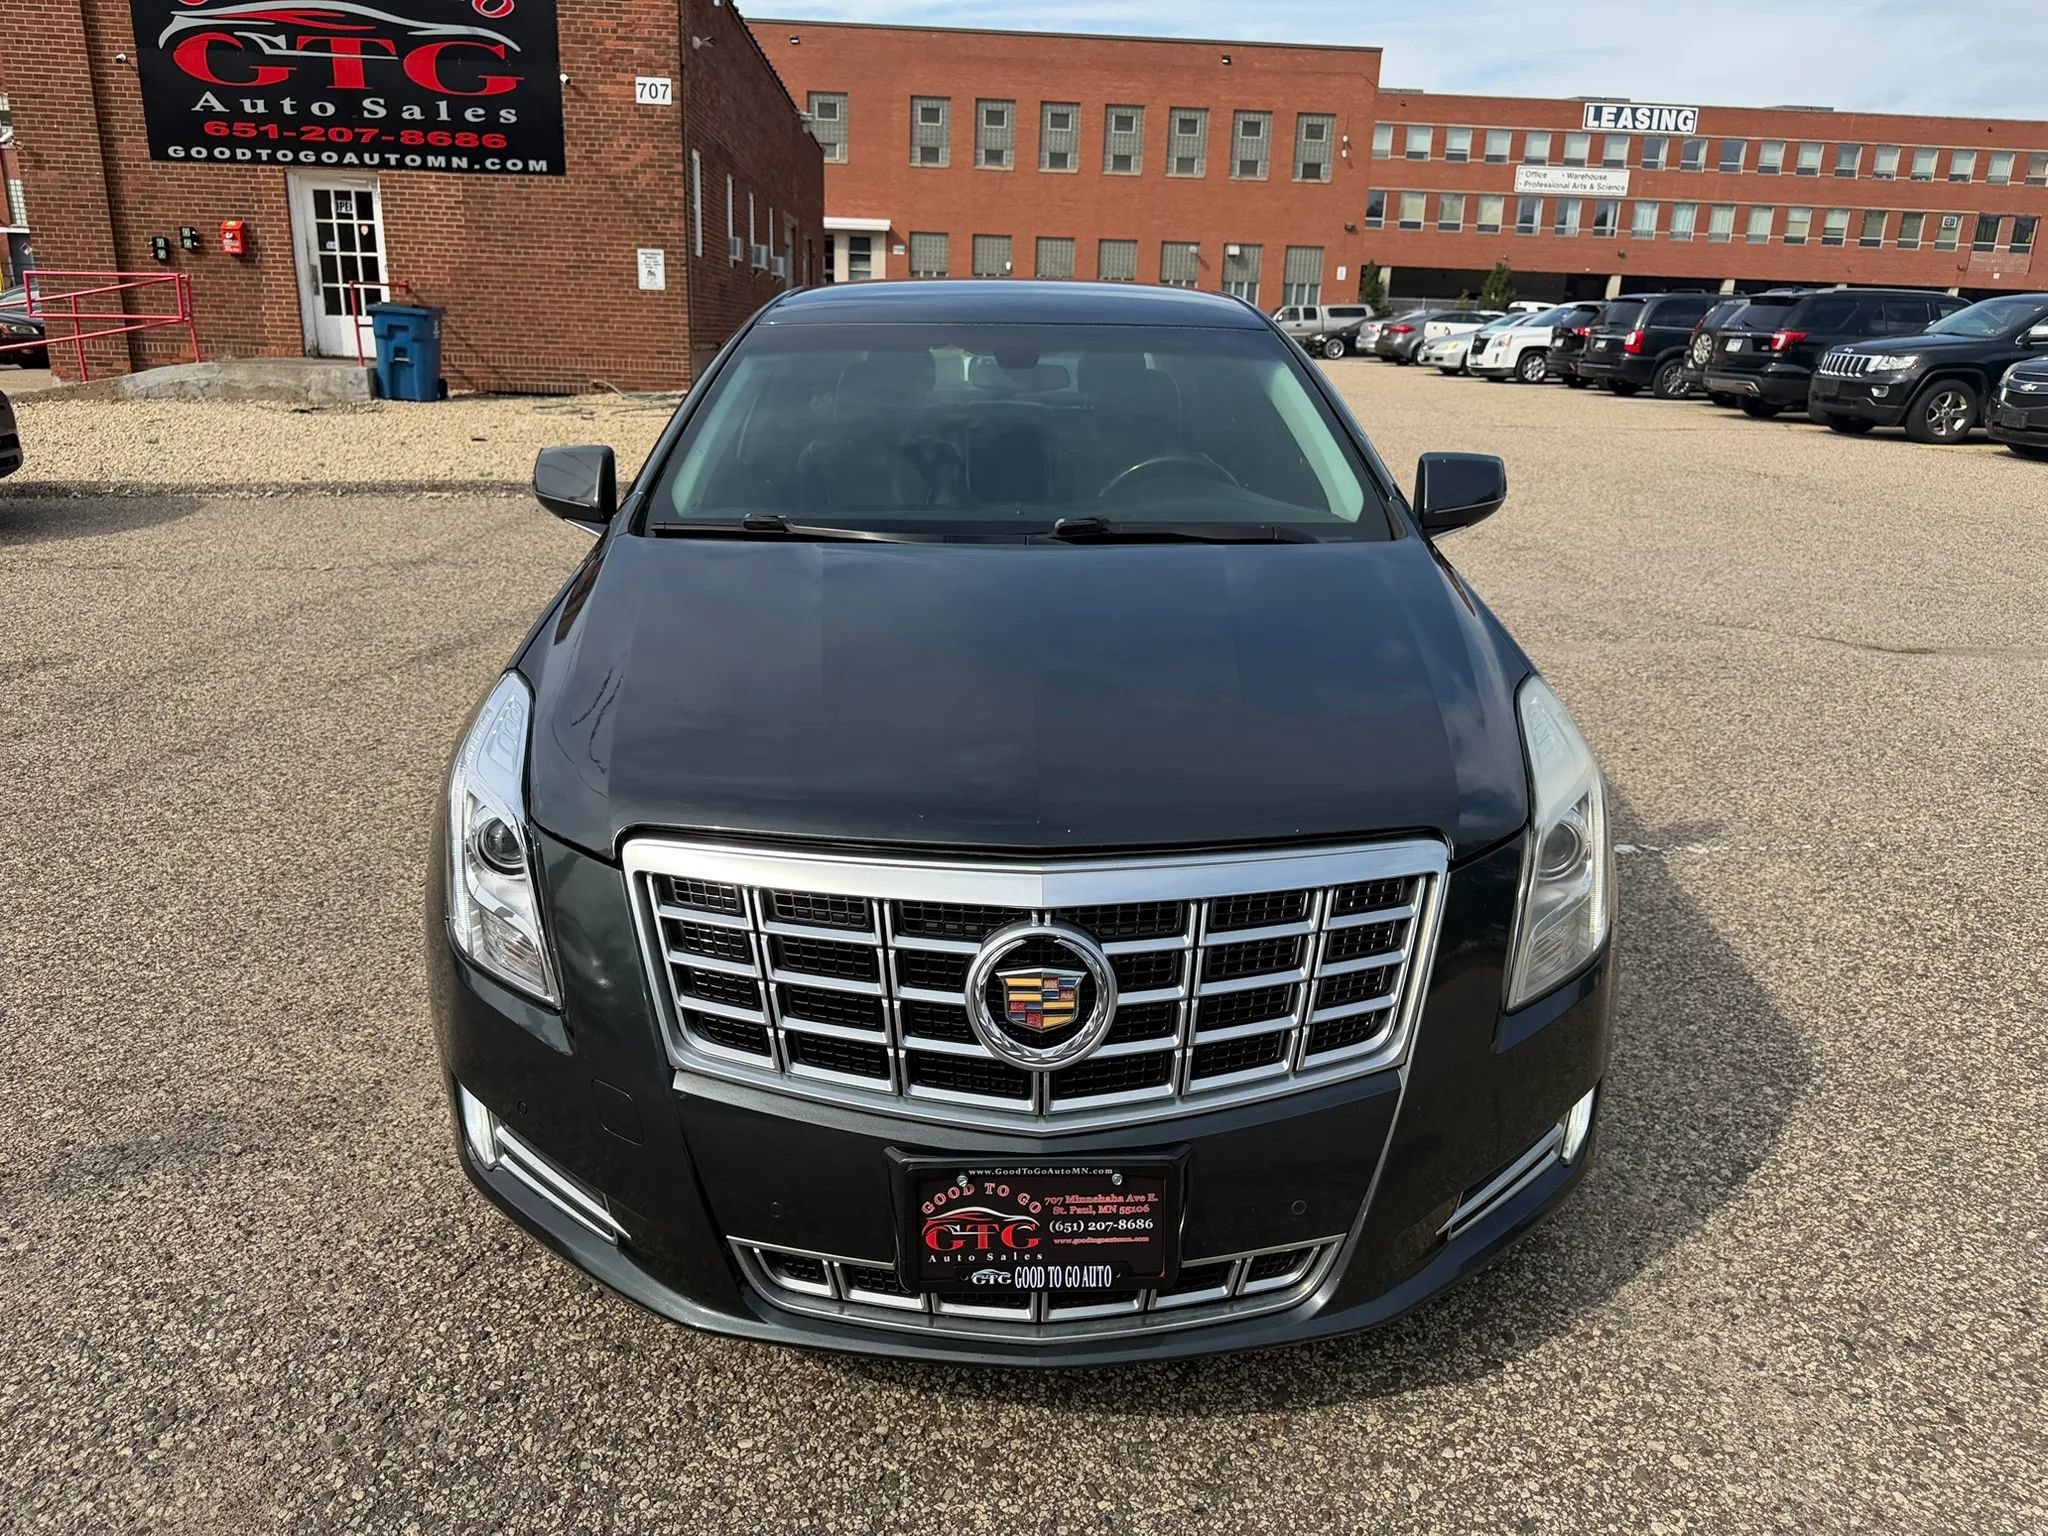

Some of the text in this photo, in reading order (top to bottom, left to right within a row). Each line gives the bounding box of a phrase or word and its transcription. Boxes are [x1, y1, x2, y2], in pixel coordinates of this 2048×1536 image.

[172, 32, 525, 95] GTG
[637, 82, 670, 100] 707
[191, 90, 518, 124] Auto Sales
[1586, 106, 1695, 132] LEASING
[203, 120, 508, 149] 651-207-8686
[167, 145, 548, 172] GOODTOGOAUTOMN.COM
[1523, 180, 1570, 189] Professional
[1597, 183, 1626, 192] Science
[1567, 172, 1608, 181] Warehouse
[968, 1167, 1113, 1175] www.GoodToGoAutoMN.com
[921, 1182, 1042, 1214] GOOD TO GO
[1044, 1193, 1159, 1206] 707 Minnehaha Ave E.
[1052, 1204, 1150, 1216] St. Paul, MN 55106
[925, 1223, 1041, 1250] GTG
[1049, 1218, 1154, 1234] (651) 207-8686
[928, 1251, 1043, 1263] Auto Sales
[971, 1265, 1112, 1289] GTG GOOD TO GO AUTO
